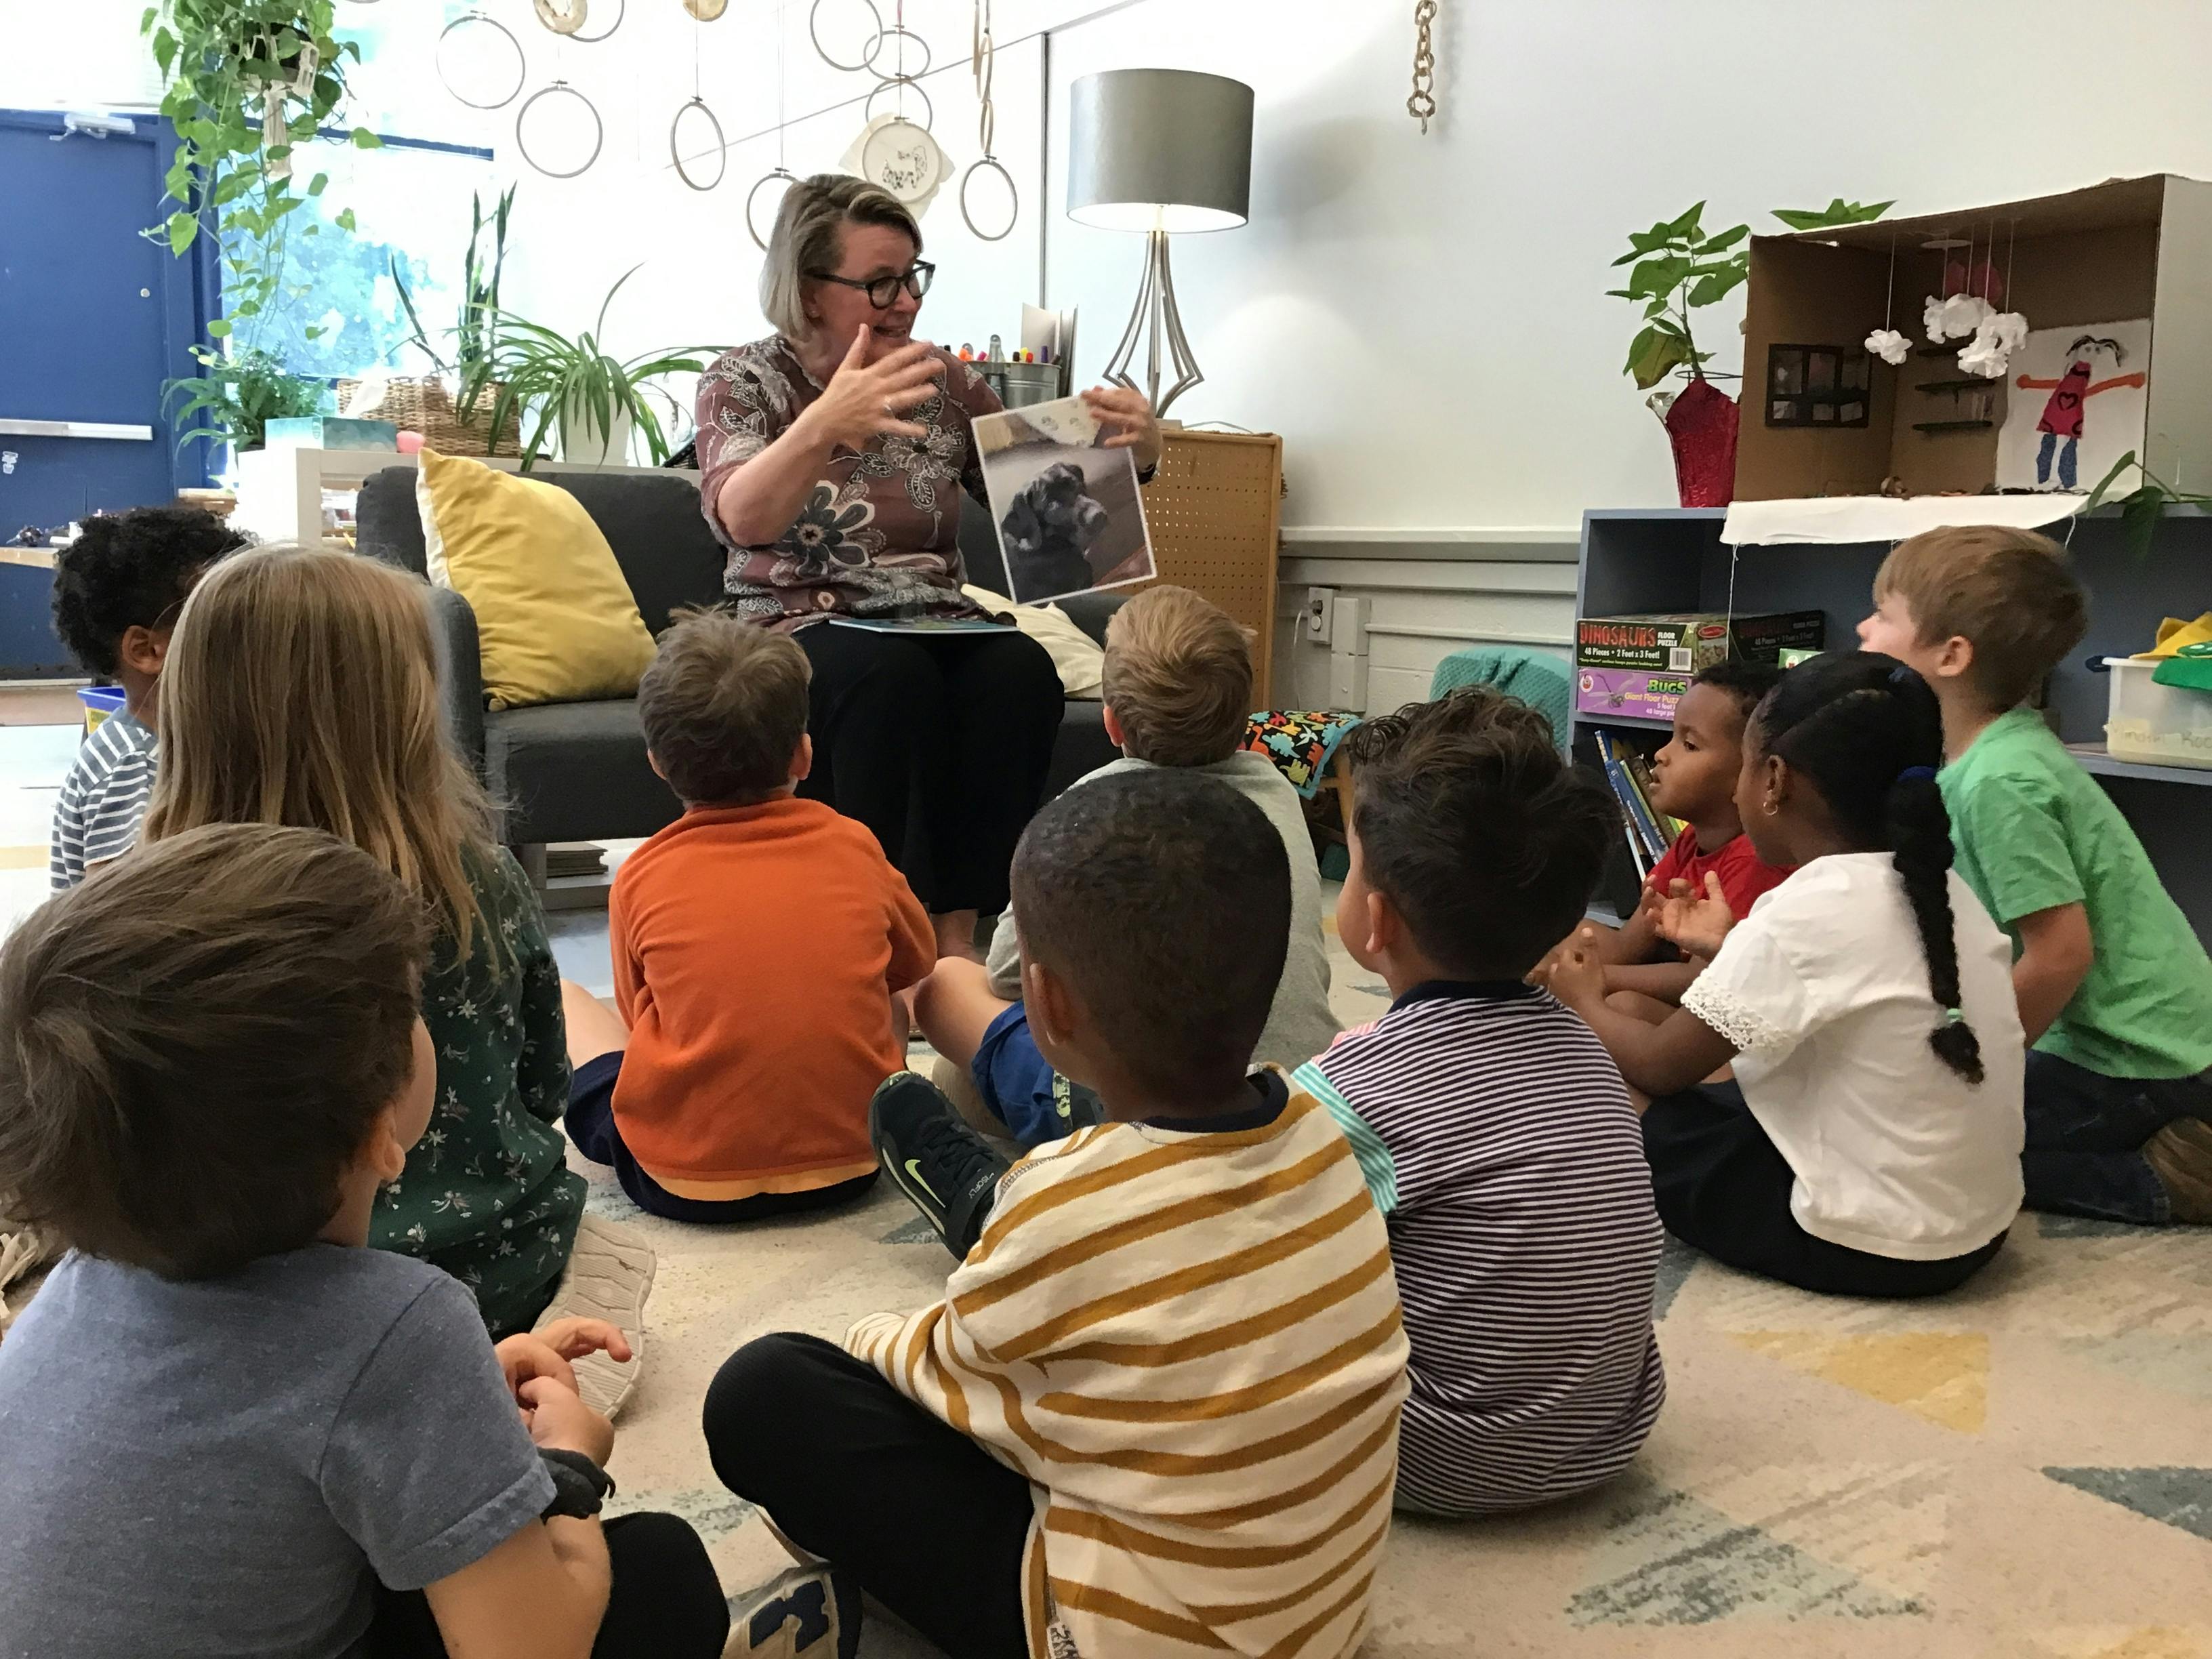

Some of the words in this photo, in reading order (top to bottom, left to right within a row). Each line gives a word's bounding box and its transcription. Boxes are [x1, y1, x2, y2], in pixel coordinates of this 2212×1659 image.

[1580, 623, 1656, 647] DINOSAURS
[1584, 647, 1592, 655] 48
[1593, 647, 1610, 656] Pieces
[1622, 649, 1634, 658] Feet
[1639, 650, 1644, 658] 3
[1647, 679, 1687, 695] BUGS
[1624, 691, 1643, 701] Giant
[1643, 693, 1661, 702] Floor
[968, 1175, 989, 1199] ISOFLY
